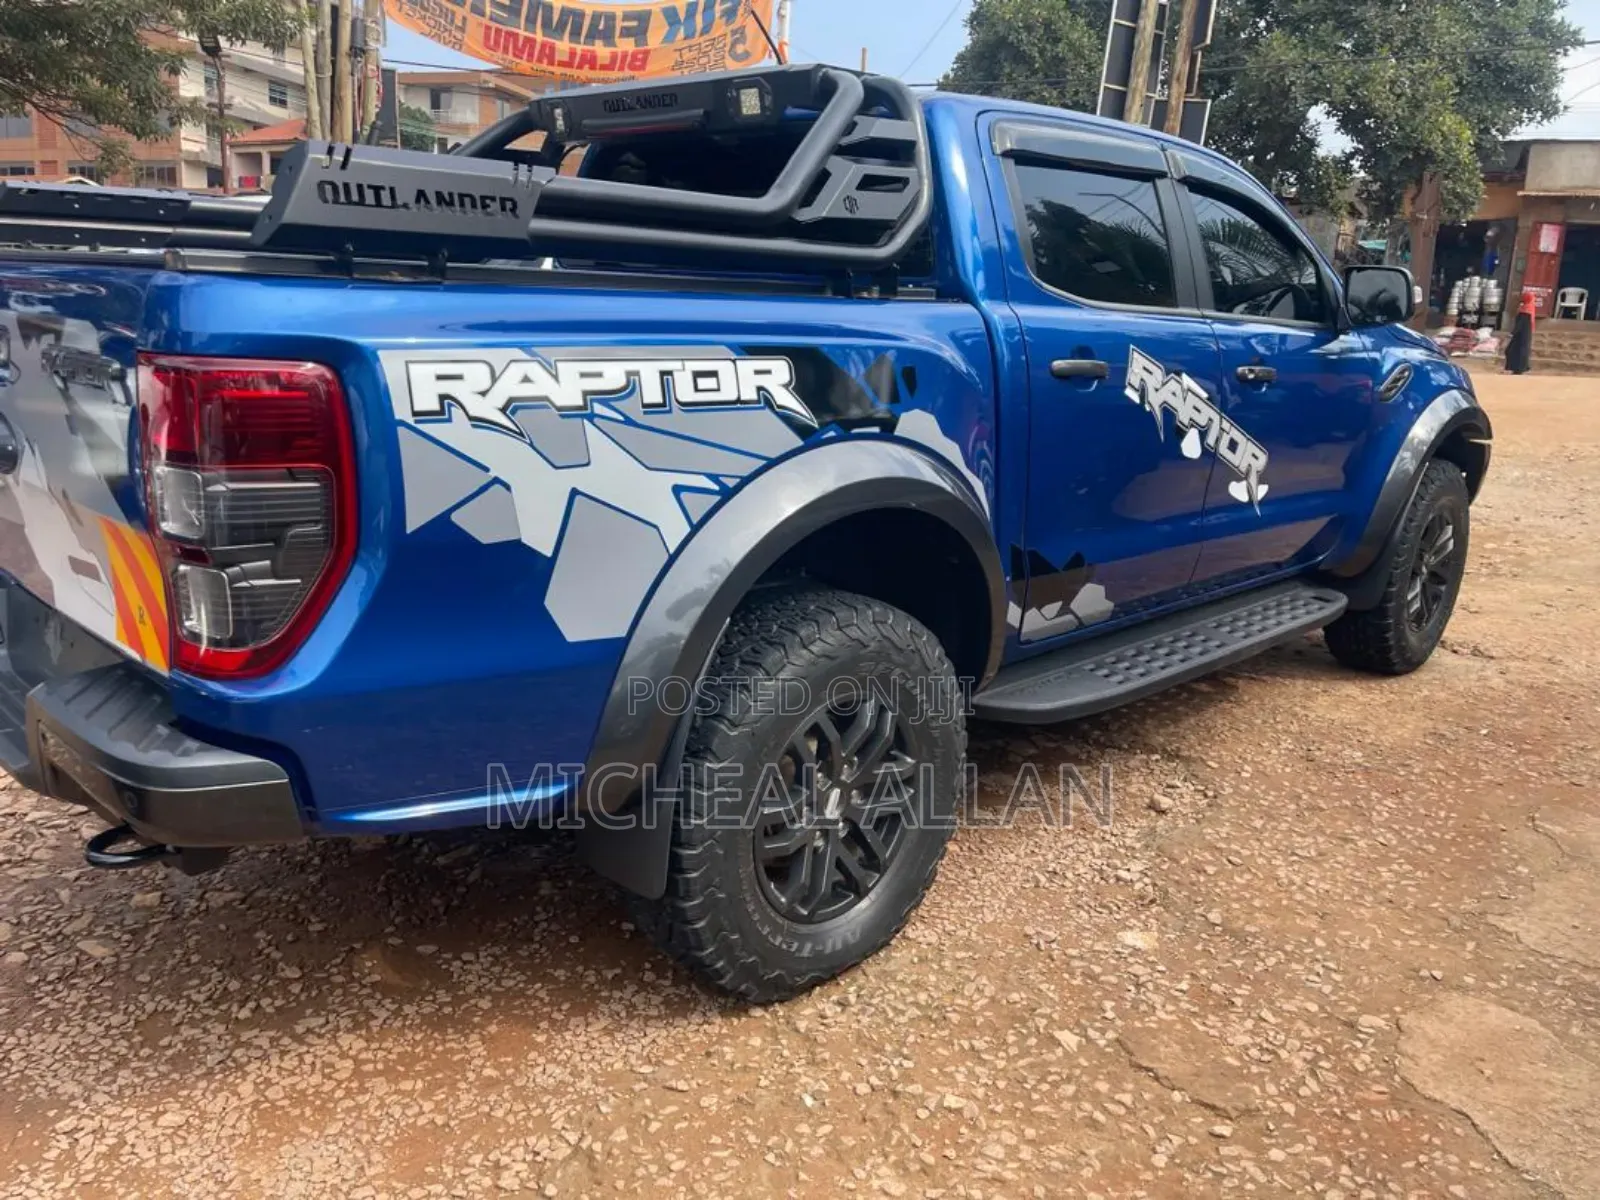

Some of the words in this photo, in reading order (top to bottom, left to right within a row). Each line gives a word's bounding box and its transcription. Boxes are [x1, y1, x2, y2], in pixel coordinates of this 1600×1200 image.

[316, 179, 520, 219] OUTLANDER
[405, 357, 819, 443] RAPTOR
[1126, 344, 1268, 517] RAPTOR
